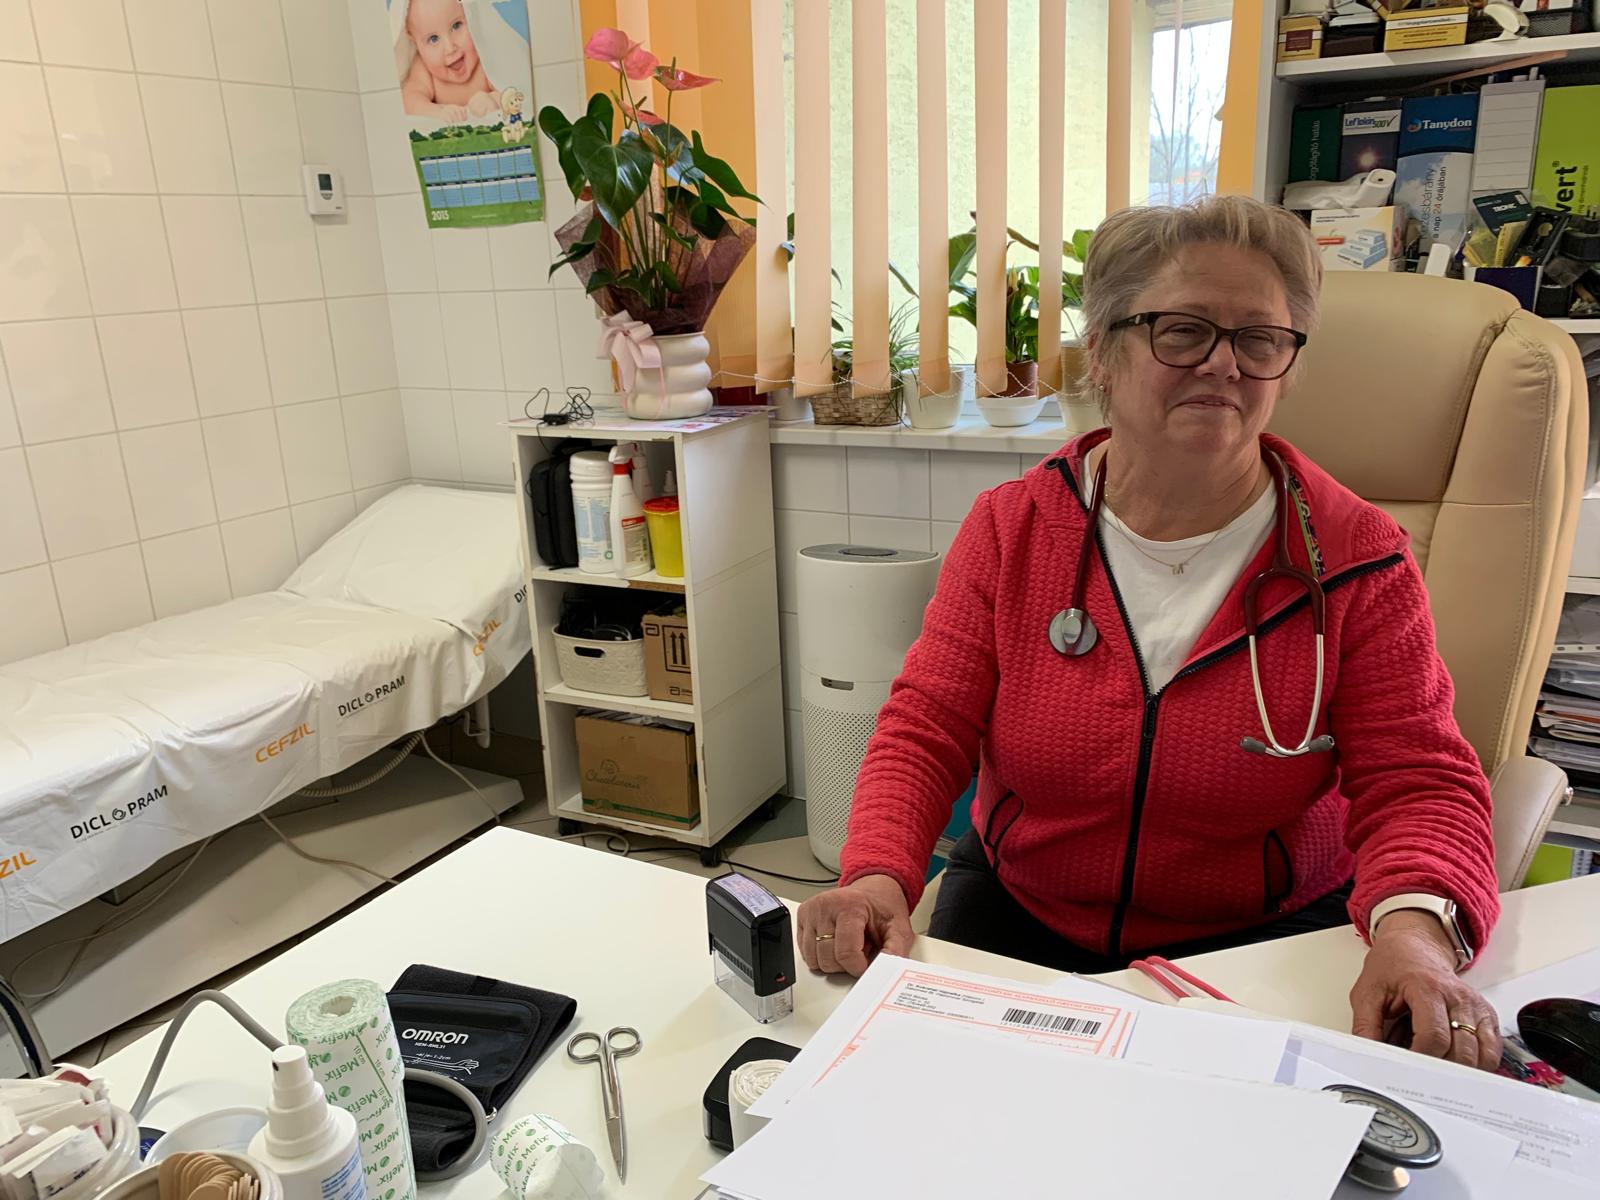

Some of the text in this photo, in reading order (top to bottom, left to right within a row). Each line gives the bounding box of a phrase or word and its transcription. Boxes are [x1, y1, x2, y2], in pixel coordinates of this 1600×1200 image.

[1422, 118, 1473, 131] Tanydon
[1433, 203, 1442, 214] 24
[1433, 216, 1443, 231] nap
[255, 722, 316, 764] CEFZIL
[402, 1028, 469, 1045] OMRON
[325, 1057, 360, 1082] Mefix
[344, 1089, 379, 1114] Mefix
[374, 1128, 399, 1151] Mefix
[502, 1119, 529, 1144] Mefix
[521, 1135, 548, 1159] Mefix
[380, 1159, 405, 1185] Mefix
[503, 1144, 519, 1178] Mefix
